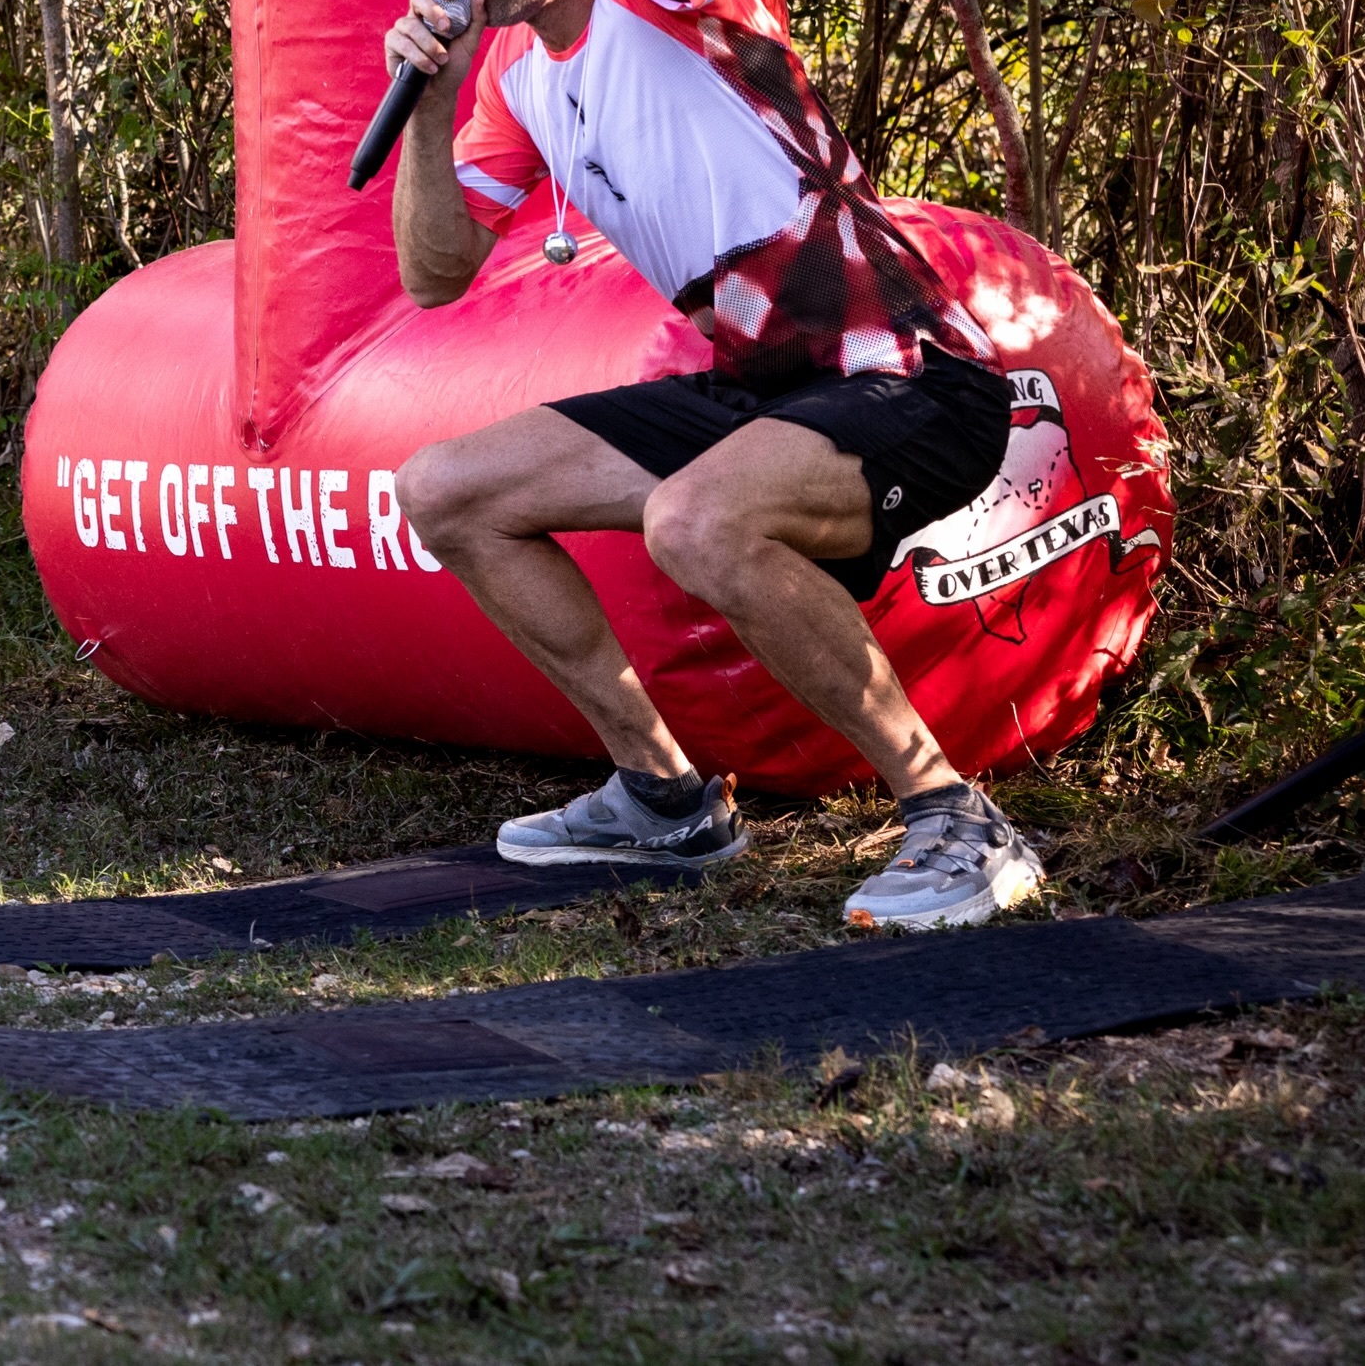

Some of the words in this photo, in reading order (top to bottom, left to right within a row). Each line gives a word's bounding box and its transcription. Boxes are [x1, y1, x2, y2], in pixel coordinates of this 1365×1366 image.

[57, 455, 148, 553] "GET
[159, 463, 238, 560] OFF
[248, 467, 357, 569] THE
[937, 550, 1020, 599] OVER
[1020, 502, 1111, 564] TEXAS
